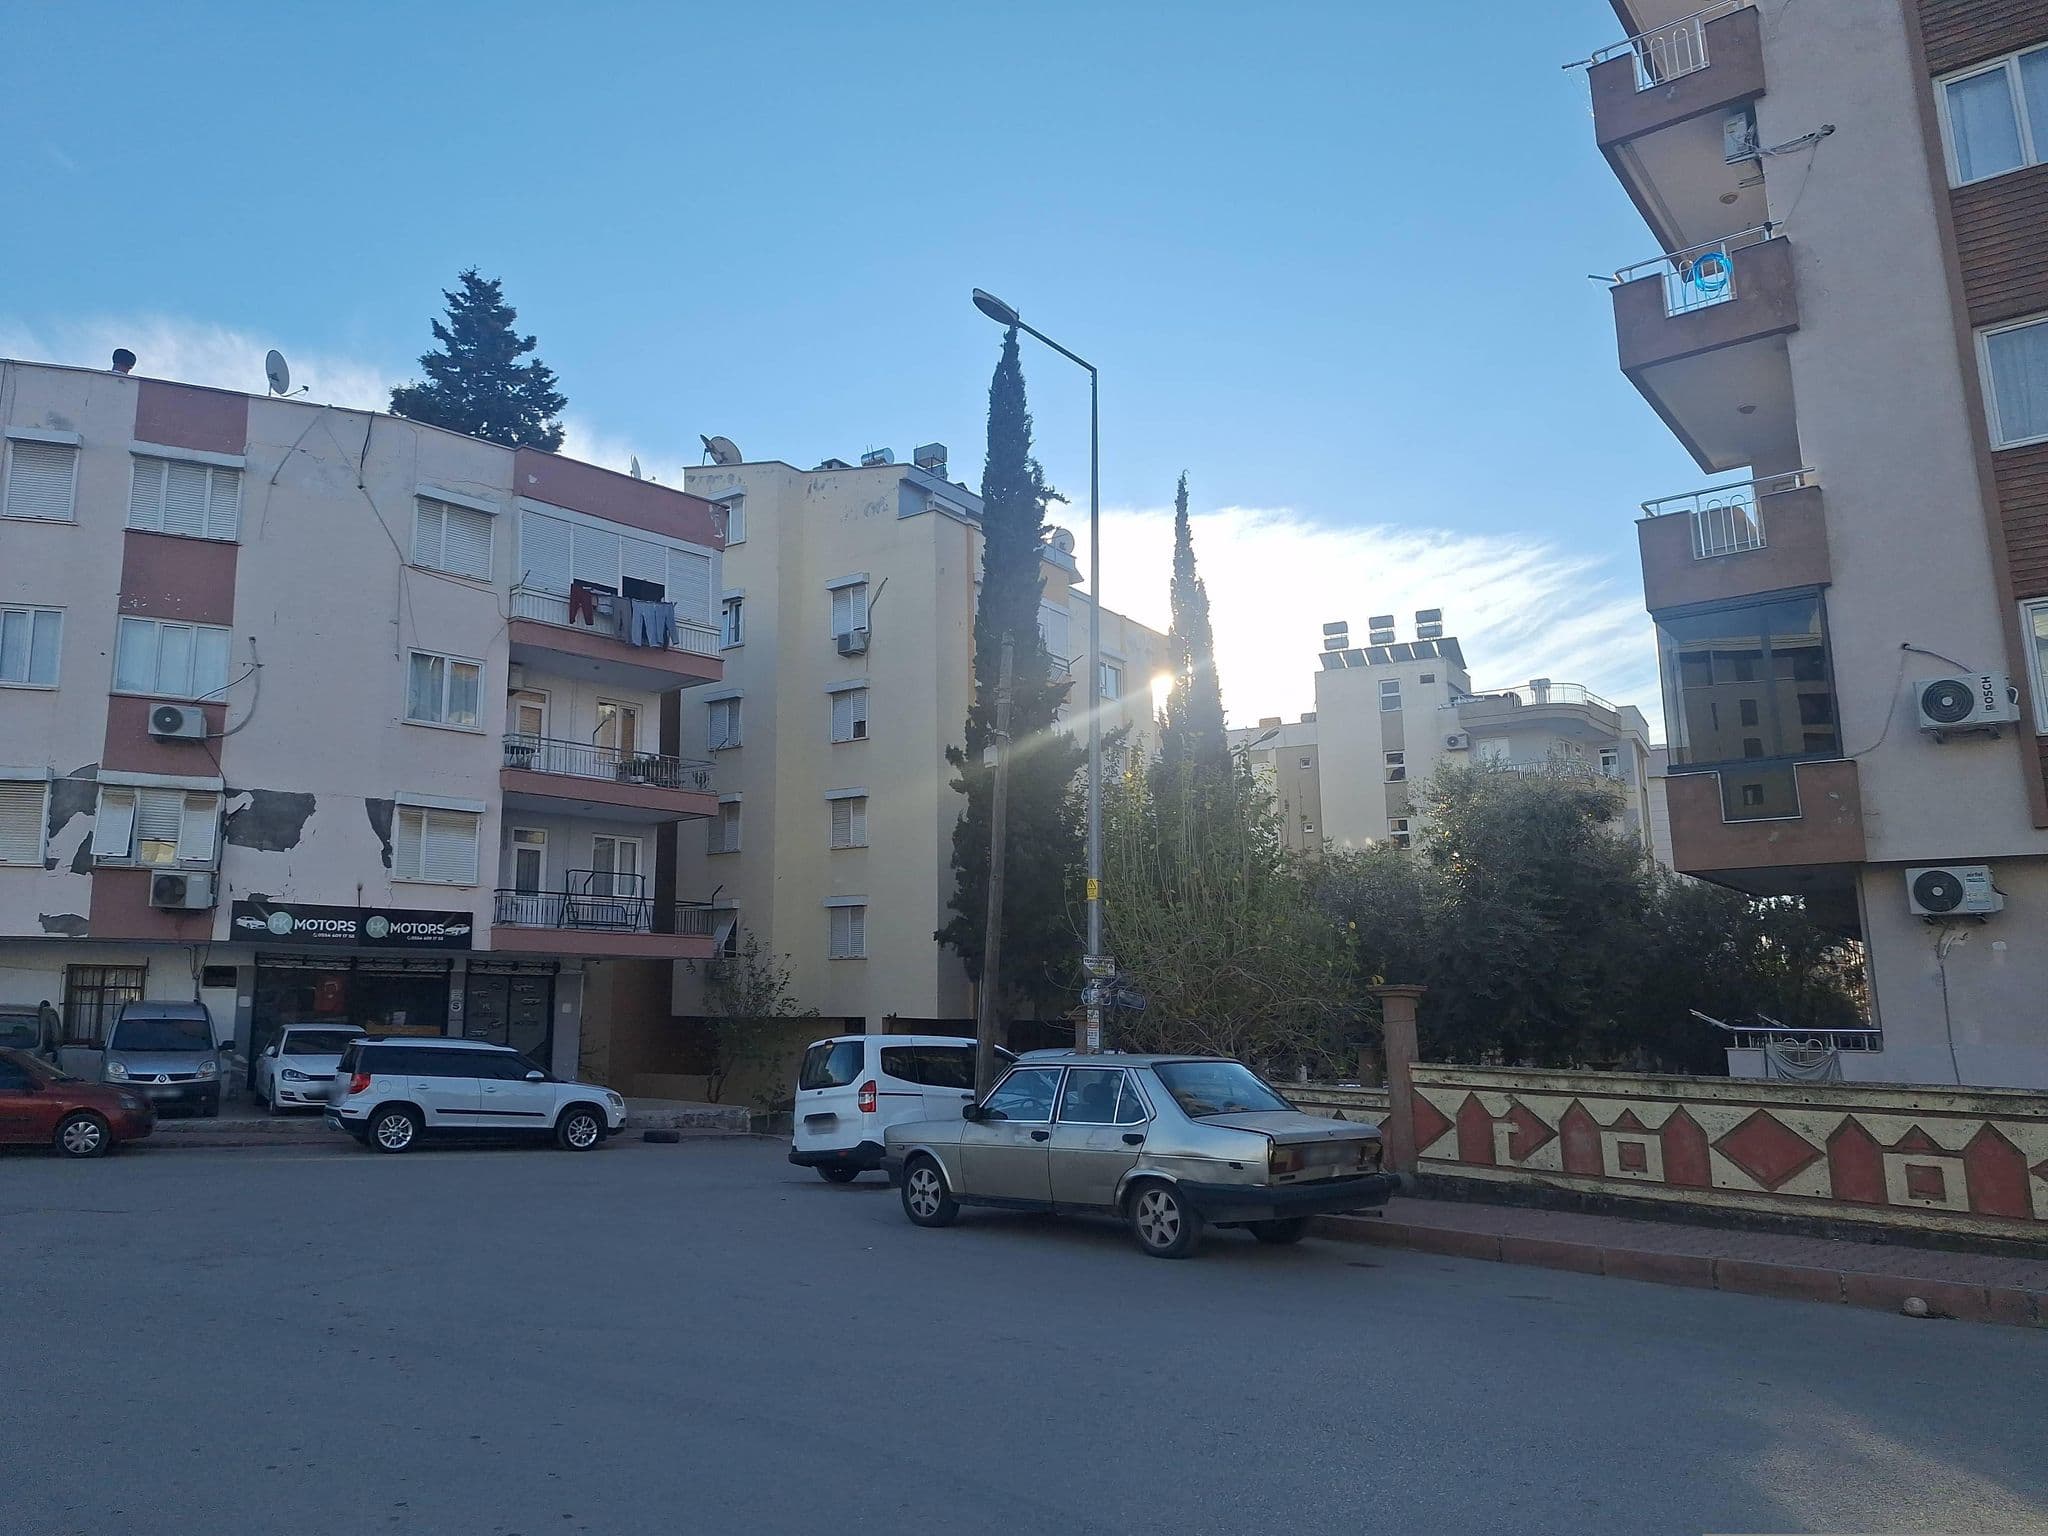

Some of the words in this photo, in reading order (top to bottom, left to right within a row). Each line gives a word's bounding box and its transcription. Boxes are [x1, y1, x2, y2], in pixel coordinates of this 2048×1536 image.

[1980, 676, 1994, 711] BOSCH
[294, 918, 357, 932] MOTORS
[390, 922, 445, 935] MOTORS
